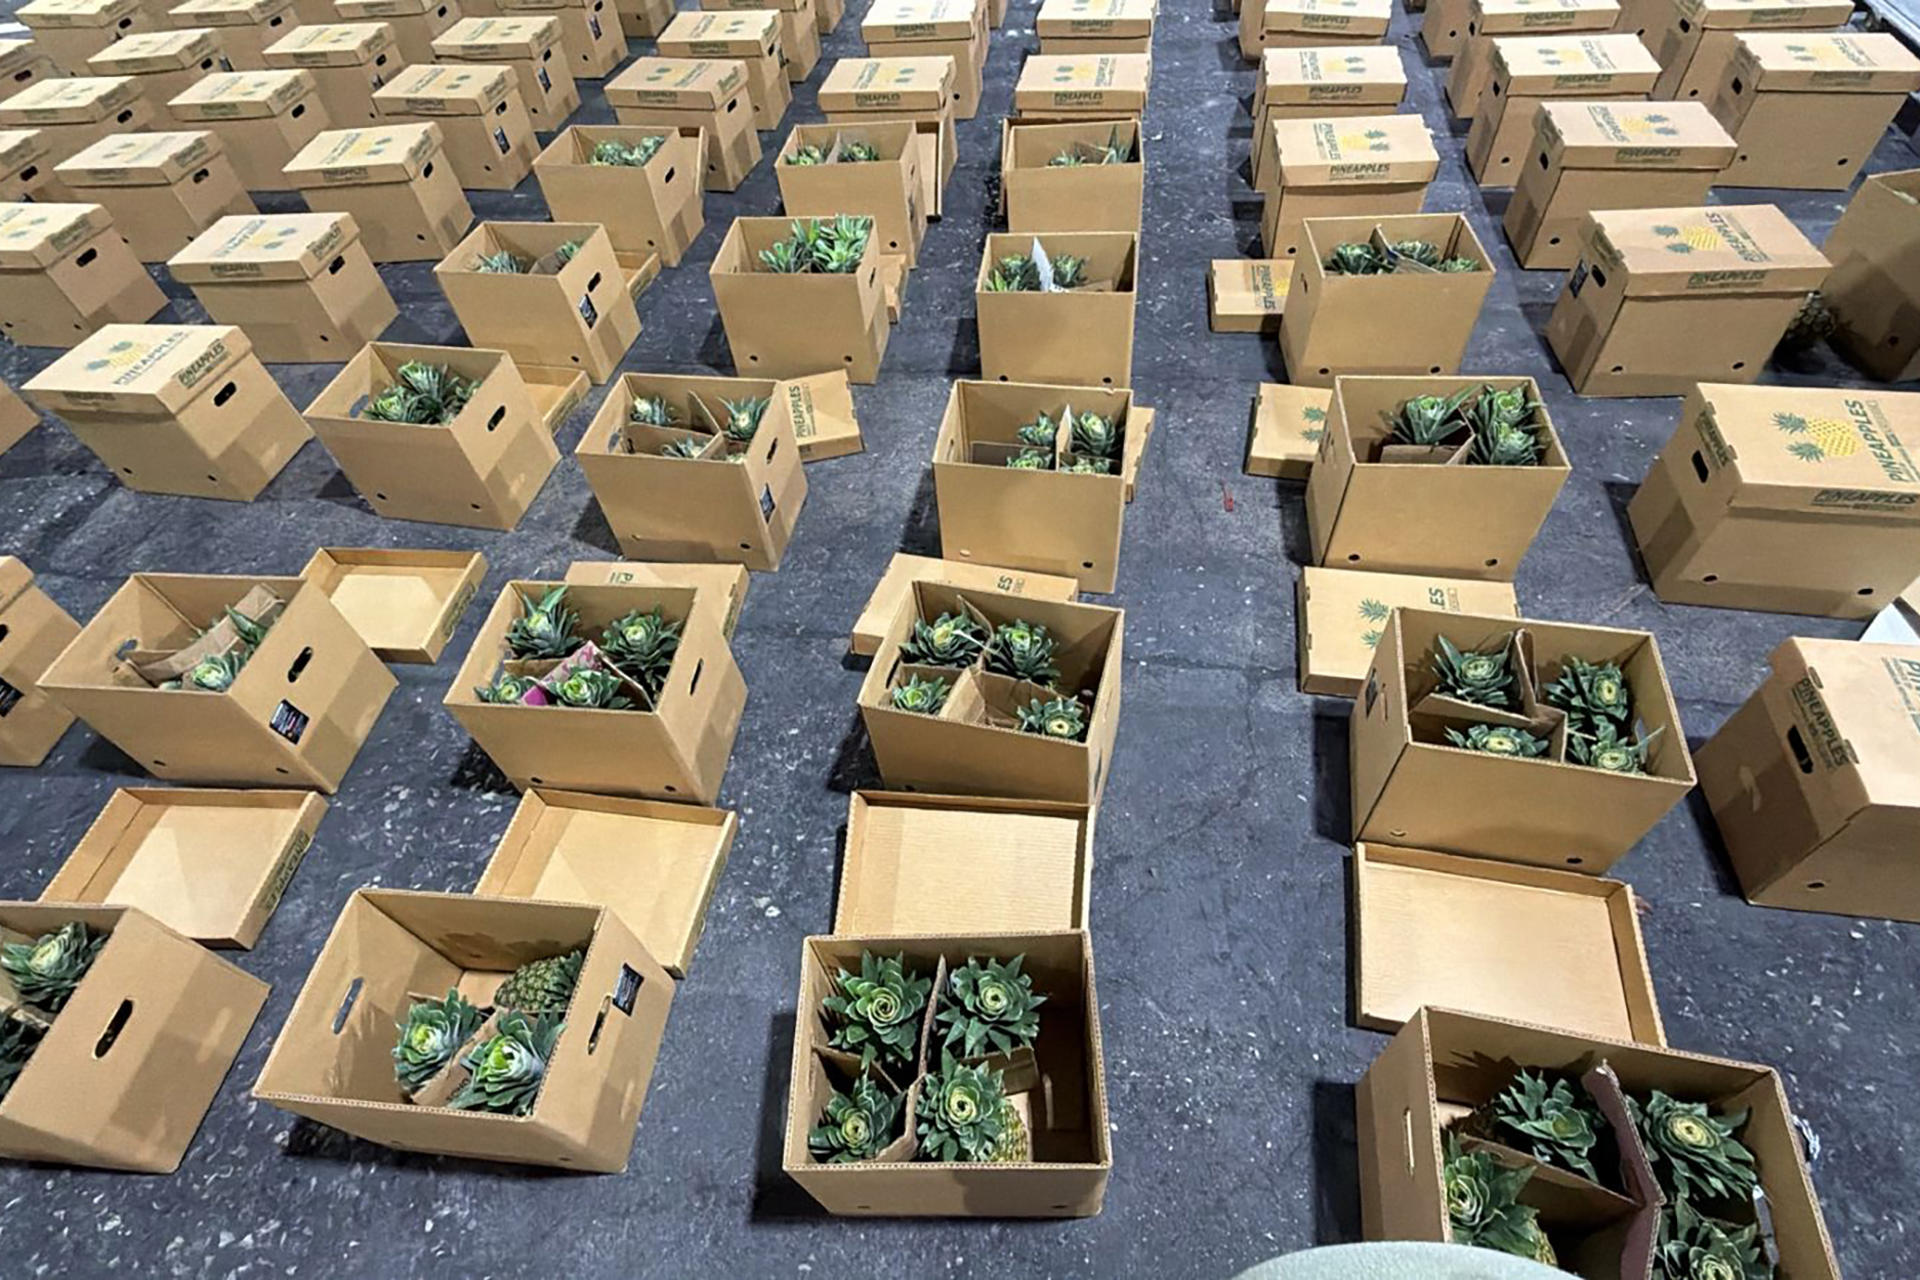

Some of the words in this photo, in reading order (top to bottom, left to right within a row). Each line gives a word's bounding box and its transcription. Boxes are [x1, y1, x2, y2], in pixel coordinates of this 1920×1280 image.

[1330, 162, 1391, 176] PINEAPPLES
[1843, 398, 1911, 483] PINEAPPLES
[1796, 677, 1850, 768] PINEAPPLES
